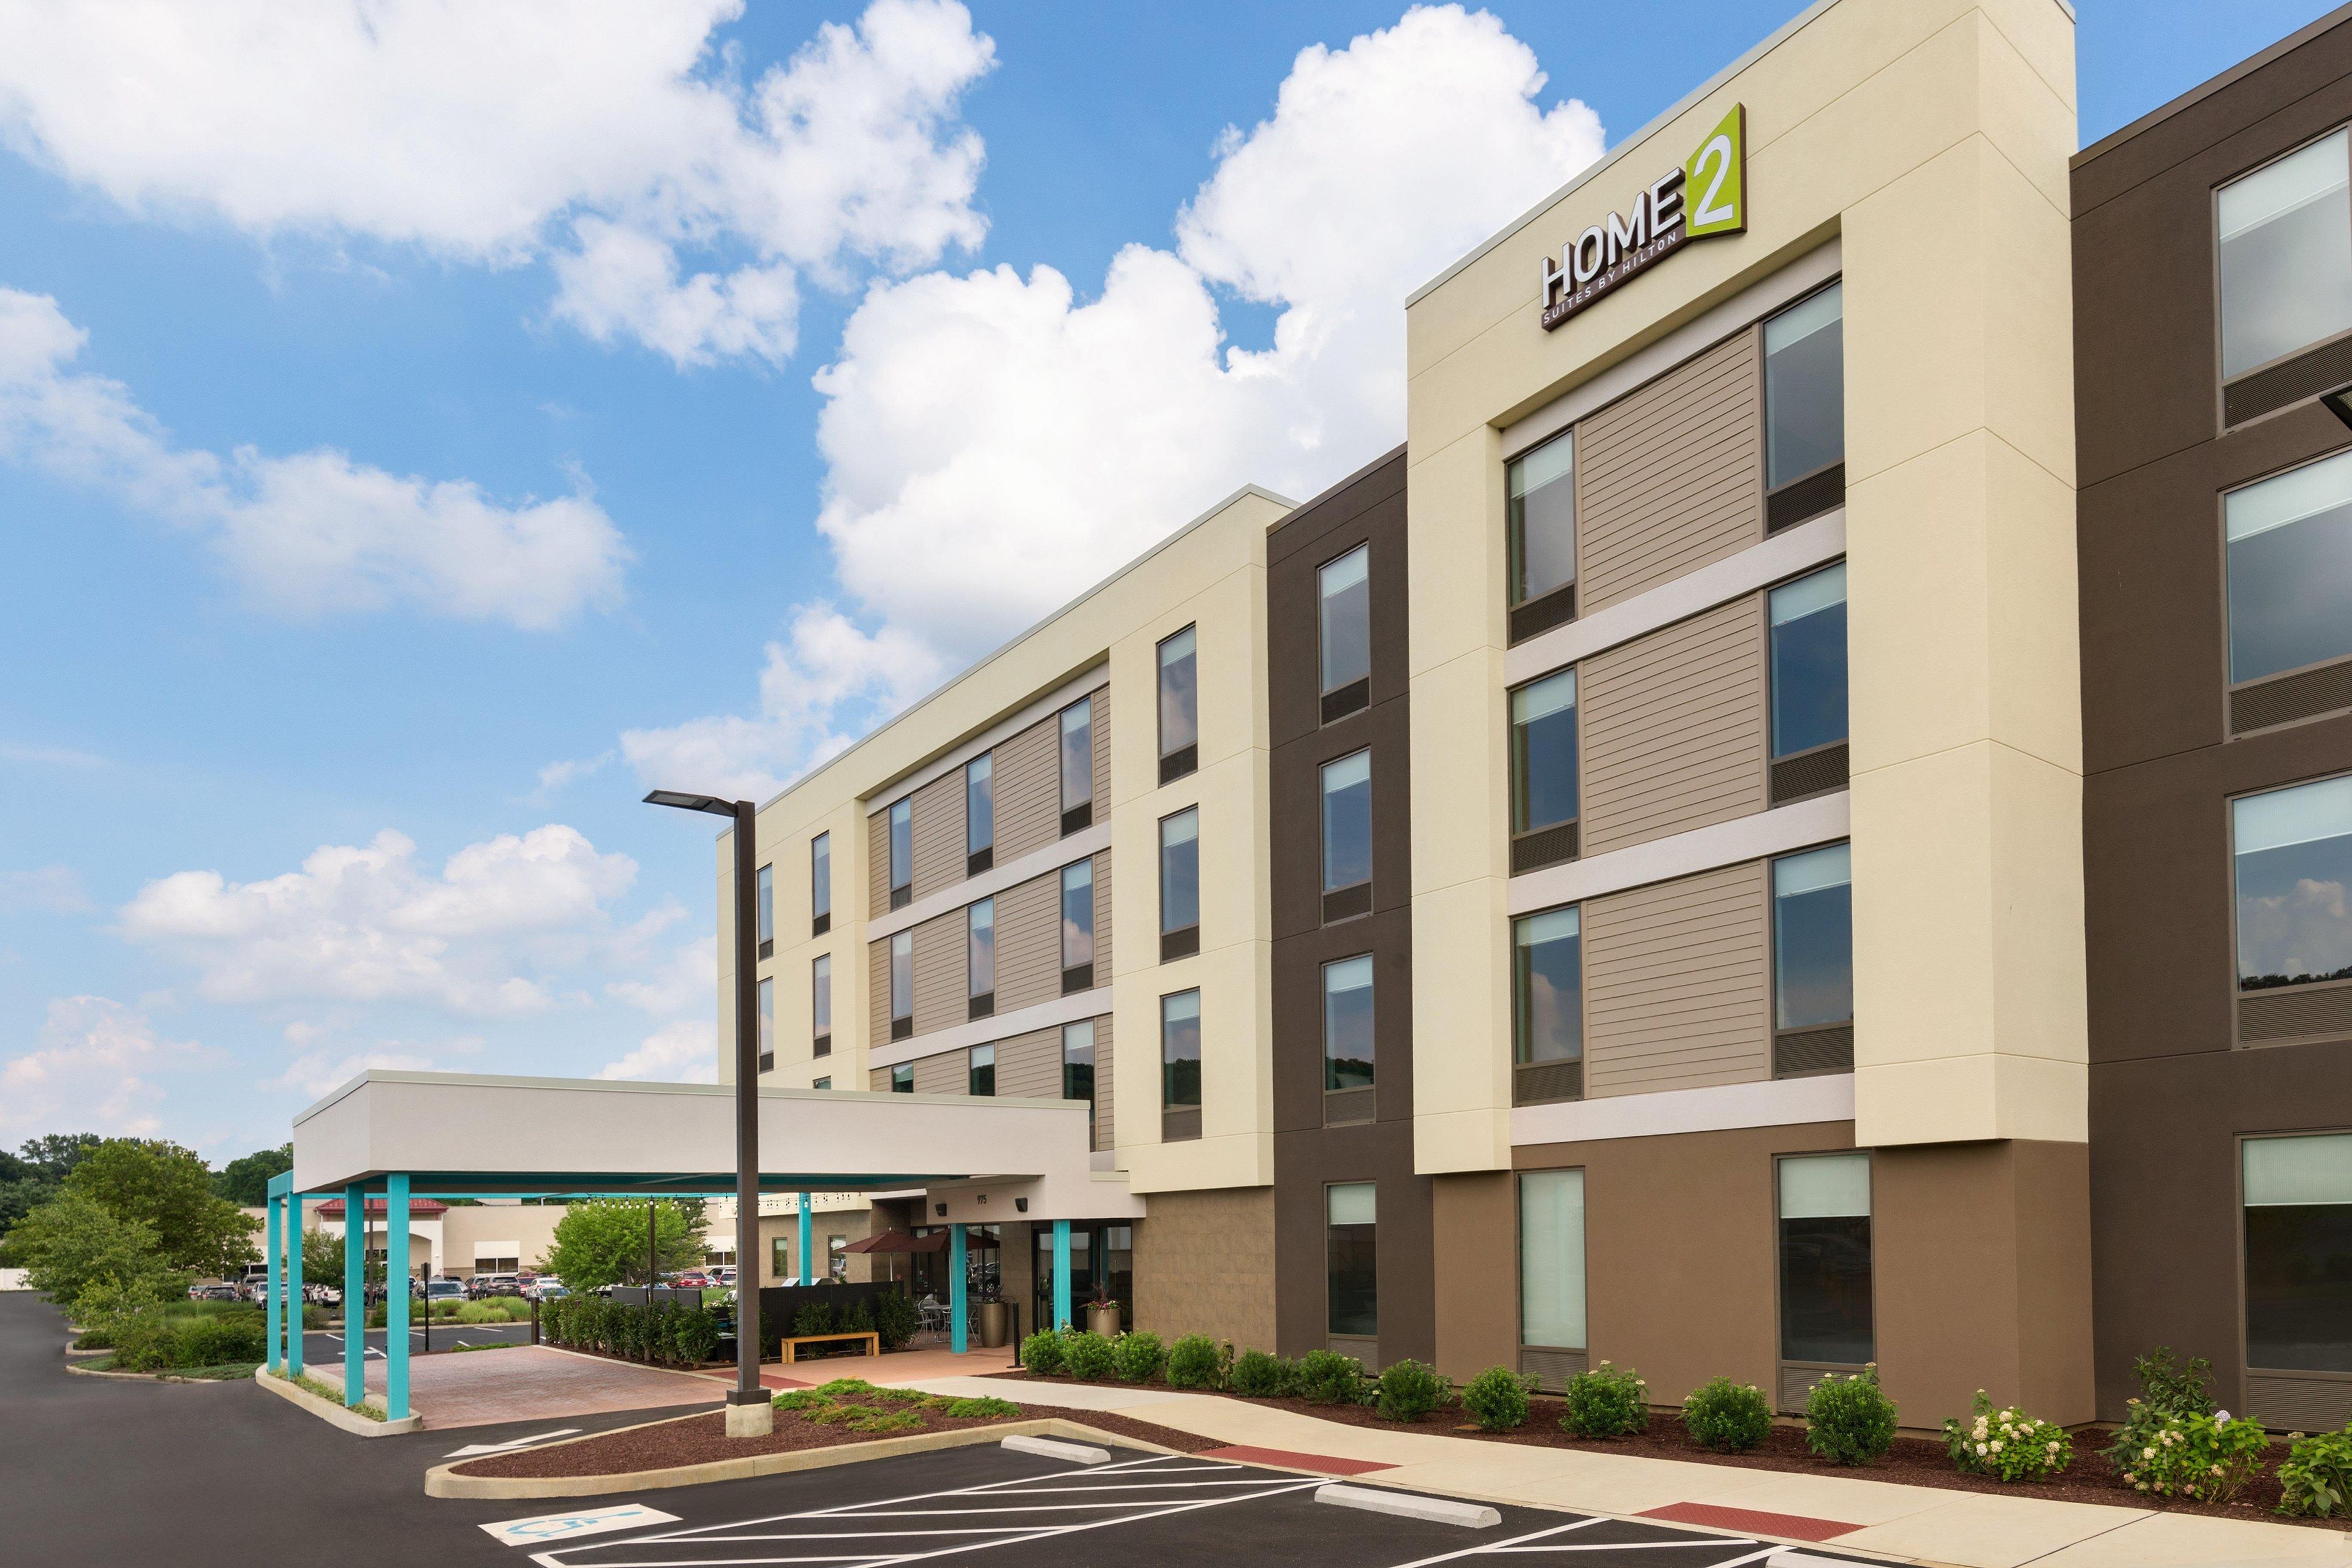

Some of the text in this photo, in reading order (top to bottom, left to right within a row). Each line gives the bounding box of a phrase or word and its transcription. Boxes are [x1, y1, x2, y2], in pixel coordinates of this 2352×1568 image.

[1544, 231, 1676, 324] SUITES BY HILTON
[977, 1194, 987, 1205] 975
